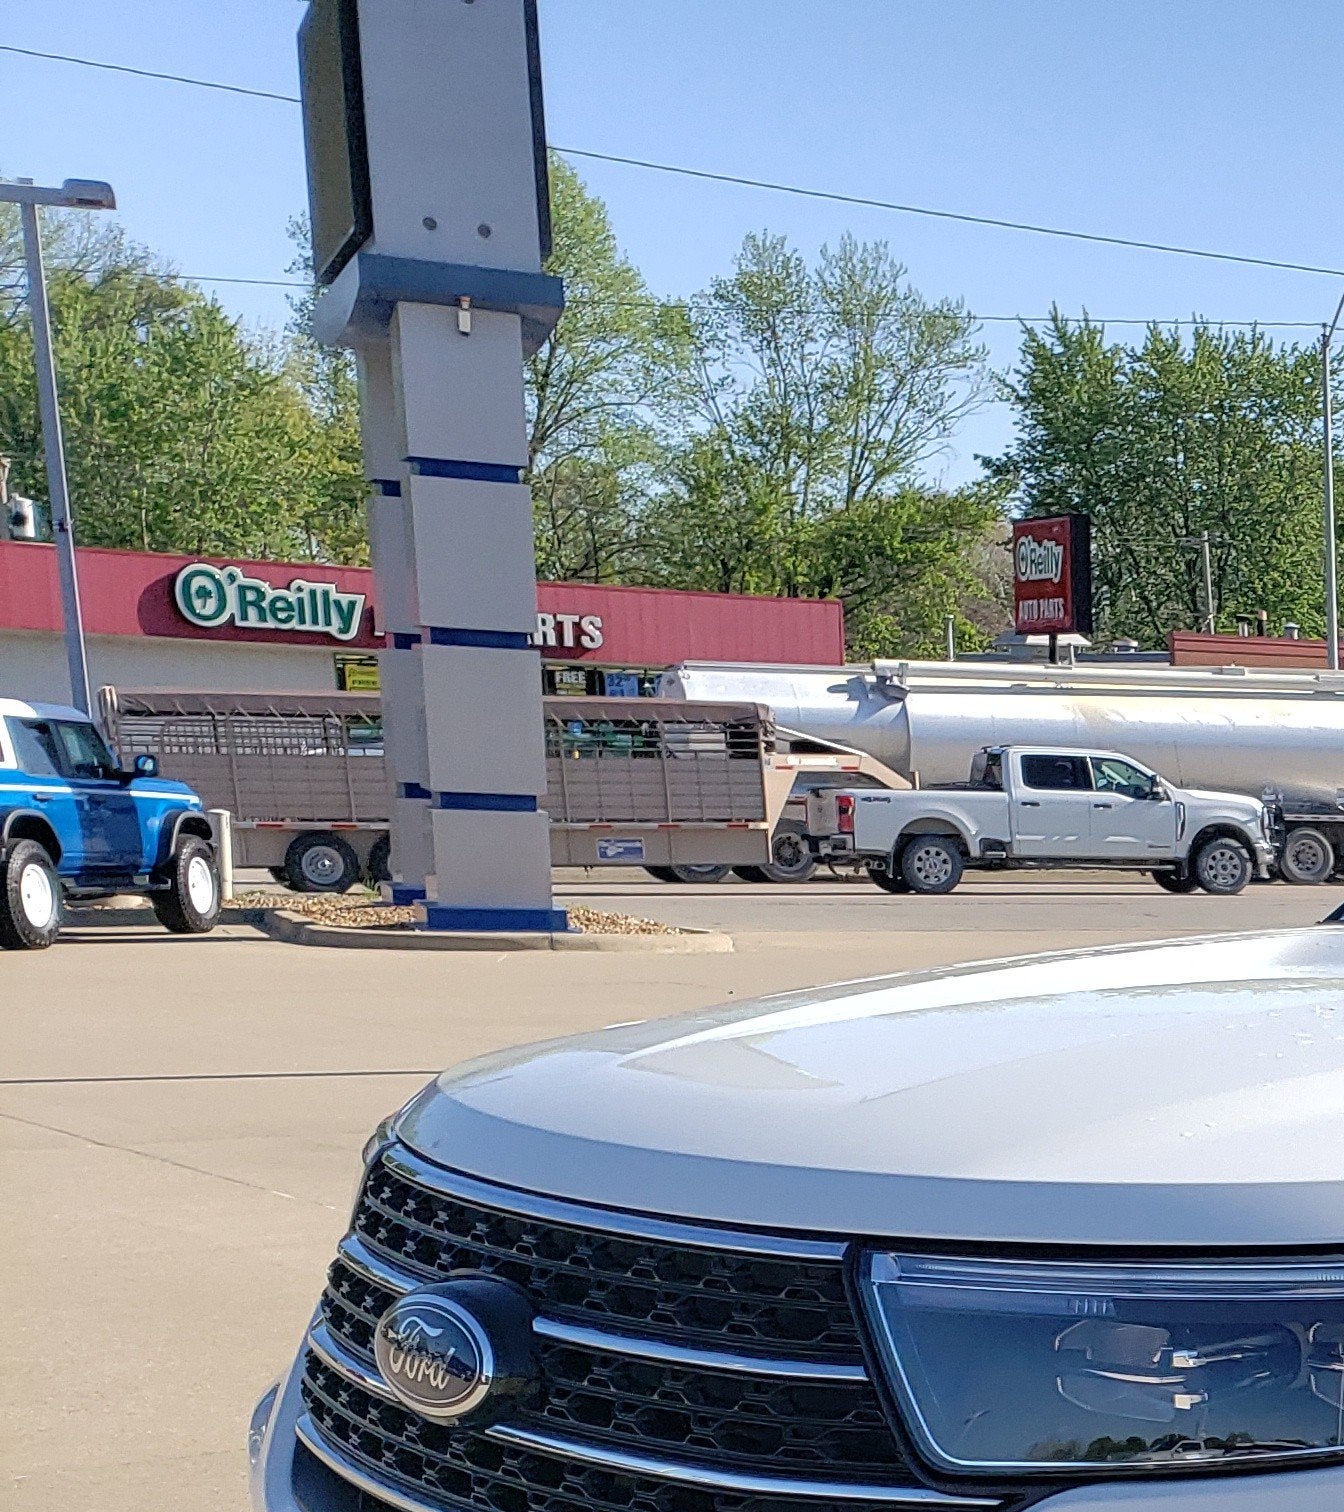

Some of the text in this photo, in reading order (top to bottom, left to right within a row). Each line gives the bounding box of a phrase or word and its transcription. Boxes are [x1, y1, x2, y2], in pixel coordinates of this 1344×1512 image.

[1018, 537, 1062, 582] O'Reilly
[179, 568, 359, 636] O'Reilly
[527, 612, 604, 649] RTS
[390, 1316, 456, 1391] Ford
